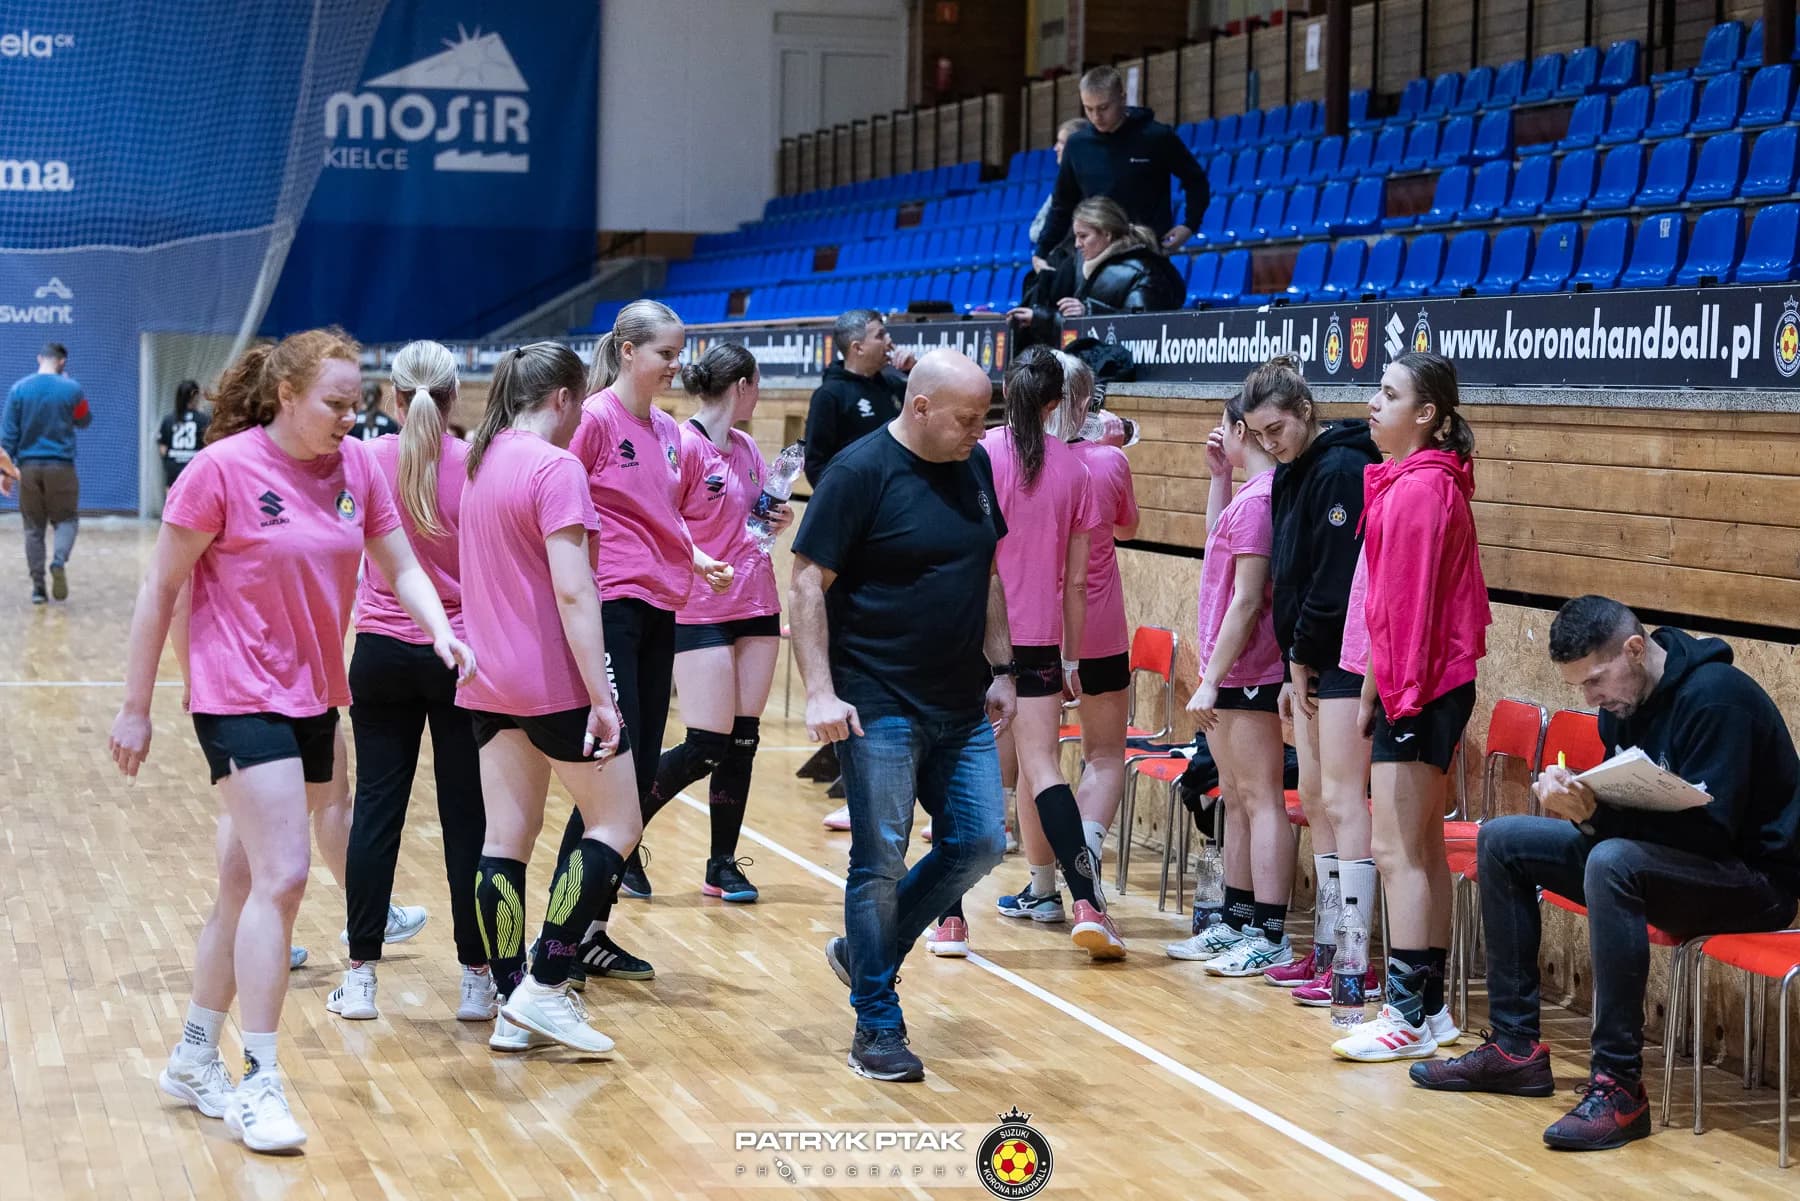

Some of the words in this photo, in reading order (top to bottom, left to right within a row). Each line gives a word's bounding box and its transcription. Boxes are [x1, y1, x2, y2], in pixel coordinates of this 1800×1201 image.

[323, 147, 409, 170] KIELCE
[1439, 303, 1762, 379] www.koronahandball.pl
[172, 421, 197, 449] 23
